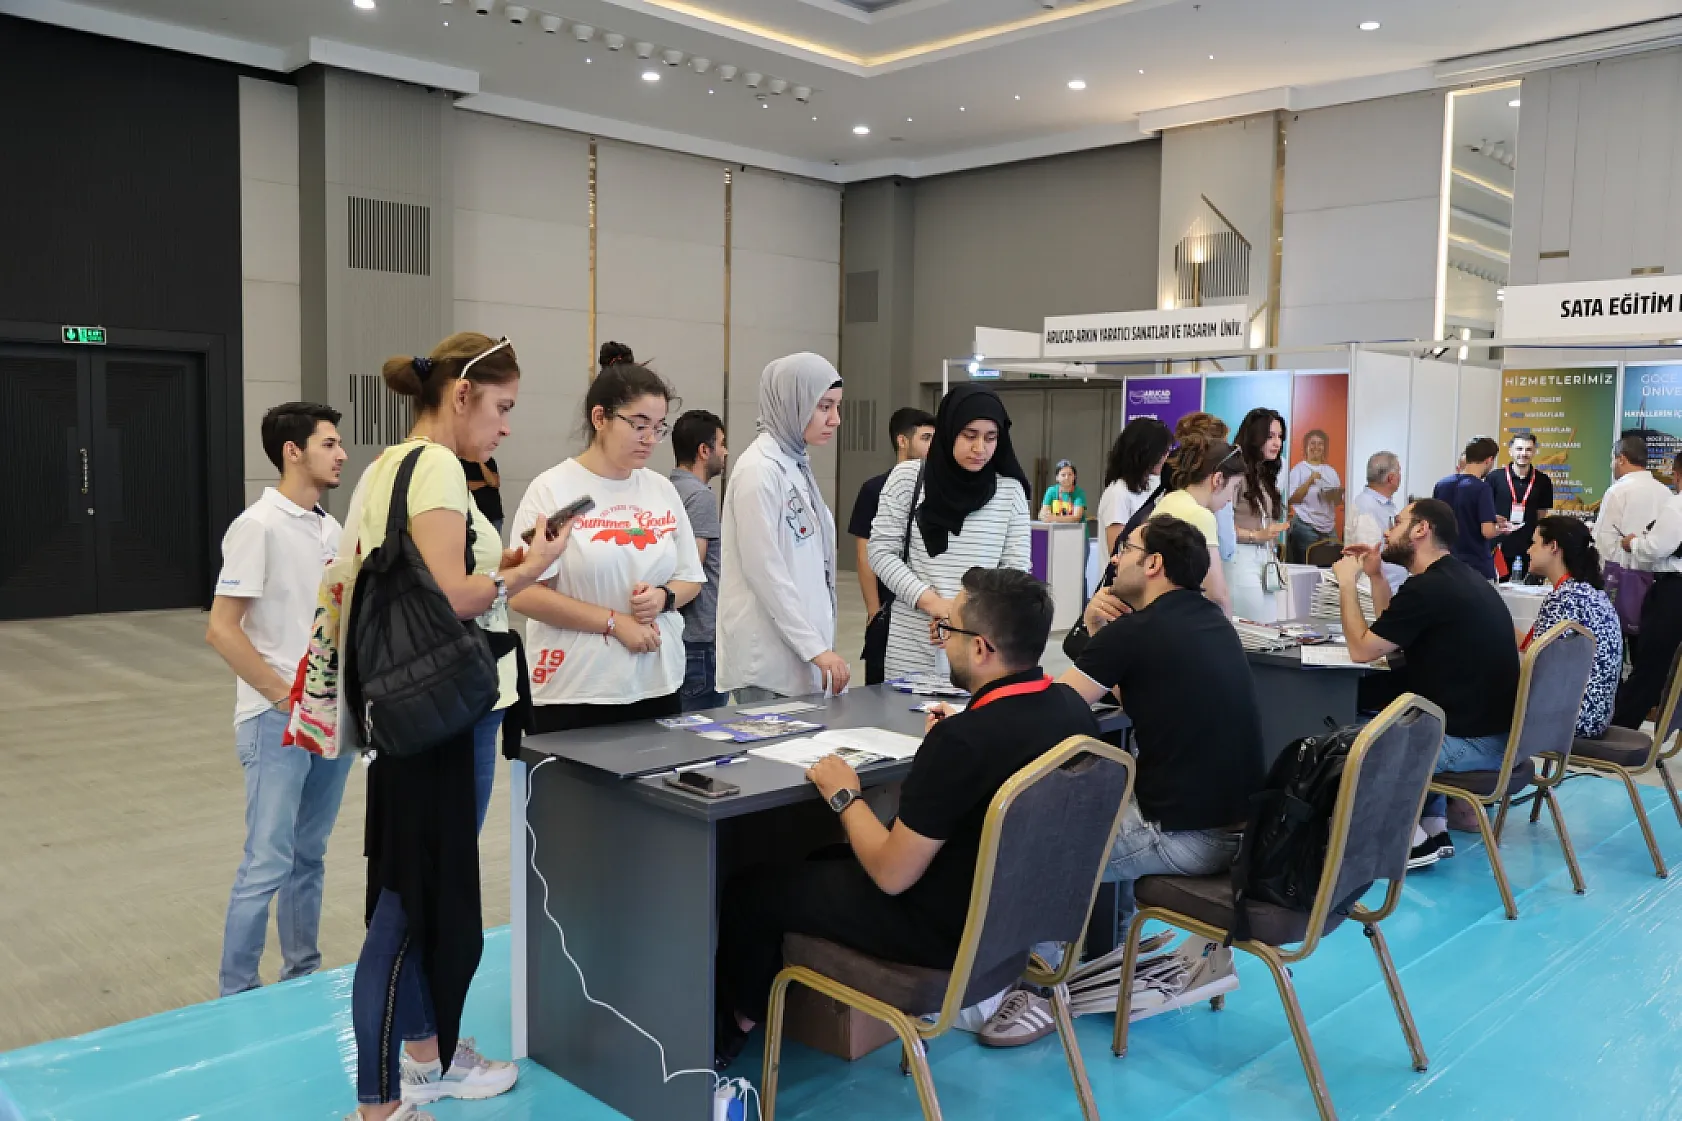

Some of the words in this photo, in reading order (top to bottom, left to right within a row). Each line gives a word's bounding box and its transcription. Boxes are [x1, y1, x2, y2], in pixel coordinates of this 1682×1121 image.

[1560, 299, 1603, 318] SATA
[1610, 292, 1674, 315] EĞİTİM
[1046, 329, 1098, 344] ARUCAD-ARKIN
[1099, 327, 1130, 342] YARATICI
[1132, 324, 1170, 341] SANATLAR
[1171, 324, 1181, 339] VE
[1183, 321, 1217, 338] TASARIM
[1220, 318, 1243, 337] ÜNİV.
[1505, 373, 1613, 387] HİZMETLERİMİZ
[573, 514, 631, 530] Summer
[633, 510, 677, 529] Goals
[537, 648, 565, 666] 19
